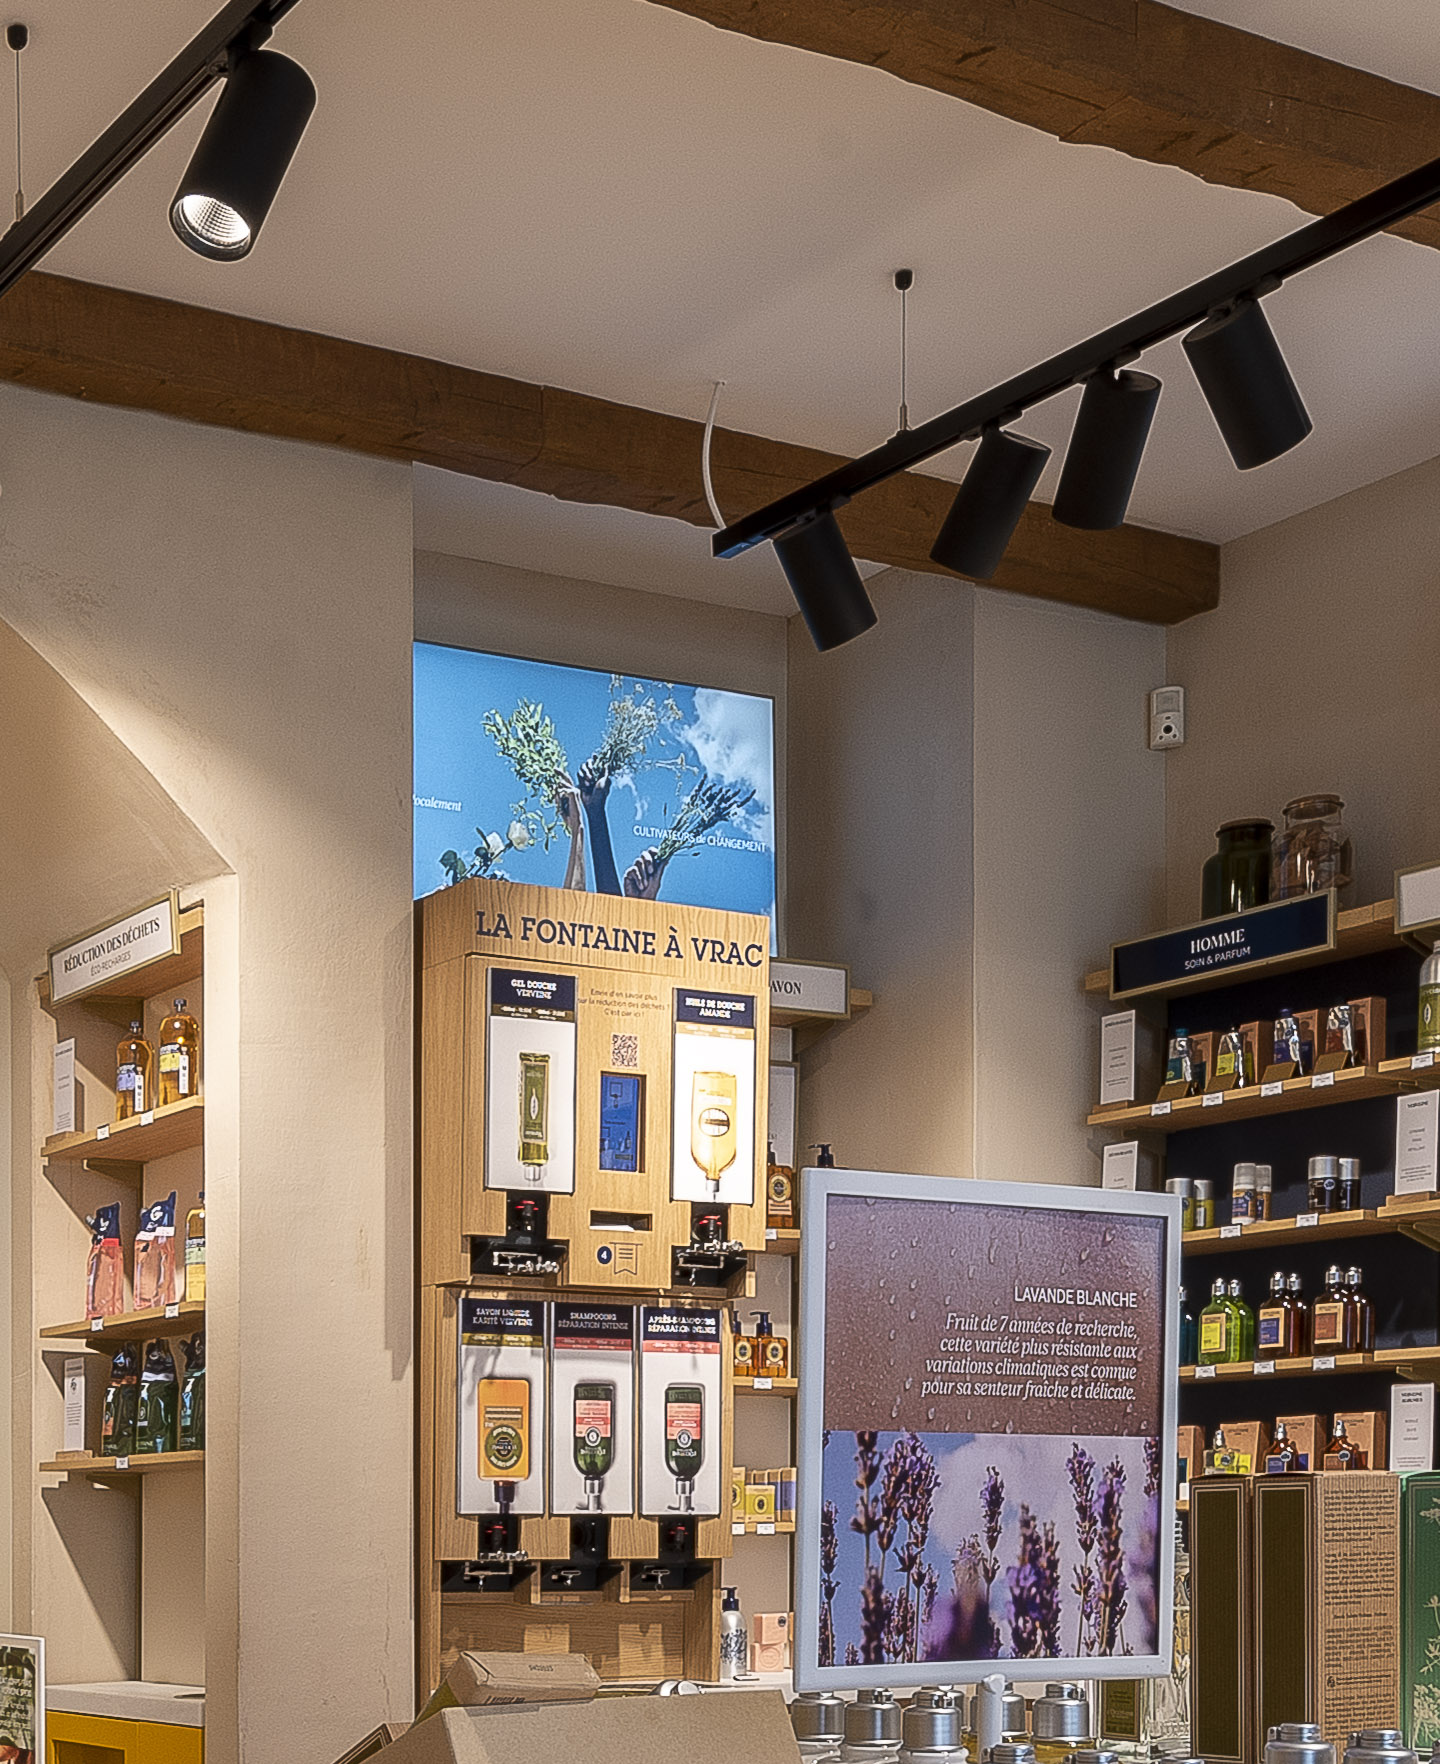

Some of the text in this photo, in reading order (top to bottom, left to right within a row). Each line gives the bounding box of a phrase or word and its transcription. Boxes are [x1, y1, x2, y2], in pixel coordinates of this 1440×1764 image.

[633, 824, 696, 845] CULTIVATEURS
[707, 835, 767, 853] CHANGEMENT
[63, 917, 161, 974] RÉDUCTION DES DÉCHETS
[476, 910, 764, 968] LA FONTAINE À VRAC
[1190, 928, 1246, 955] HOMME
[1184, 946, 1251, 971] SOIN & PARFUM
[770, 980, 802, 995] AVON
[600, 1249, 609, 1261] 4
[1014, 1285, 1138, 1308] LAVANDE BLANCHE
[945, 1312, 1138, 1340] Fruit de 7 années de recherche,
[939, 1336, 1138, 1359] cette variété plus résistante aux
[925, 1356, 1137, 1380] variations climatiques est connue
[920, 1380, 1137, 1401] pour sa senteur fraîche et délicate.
